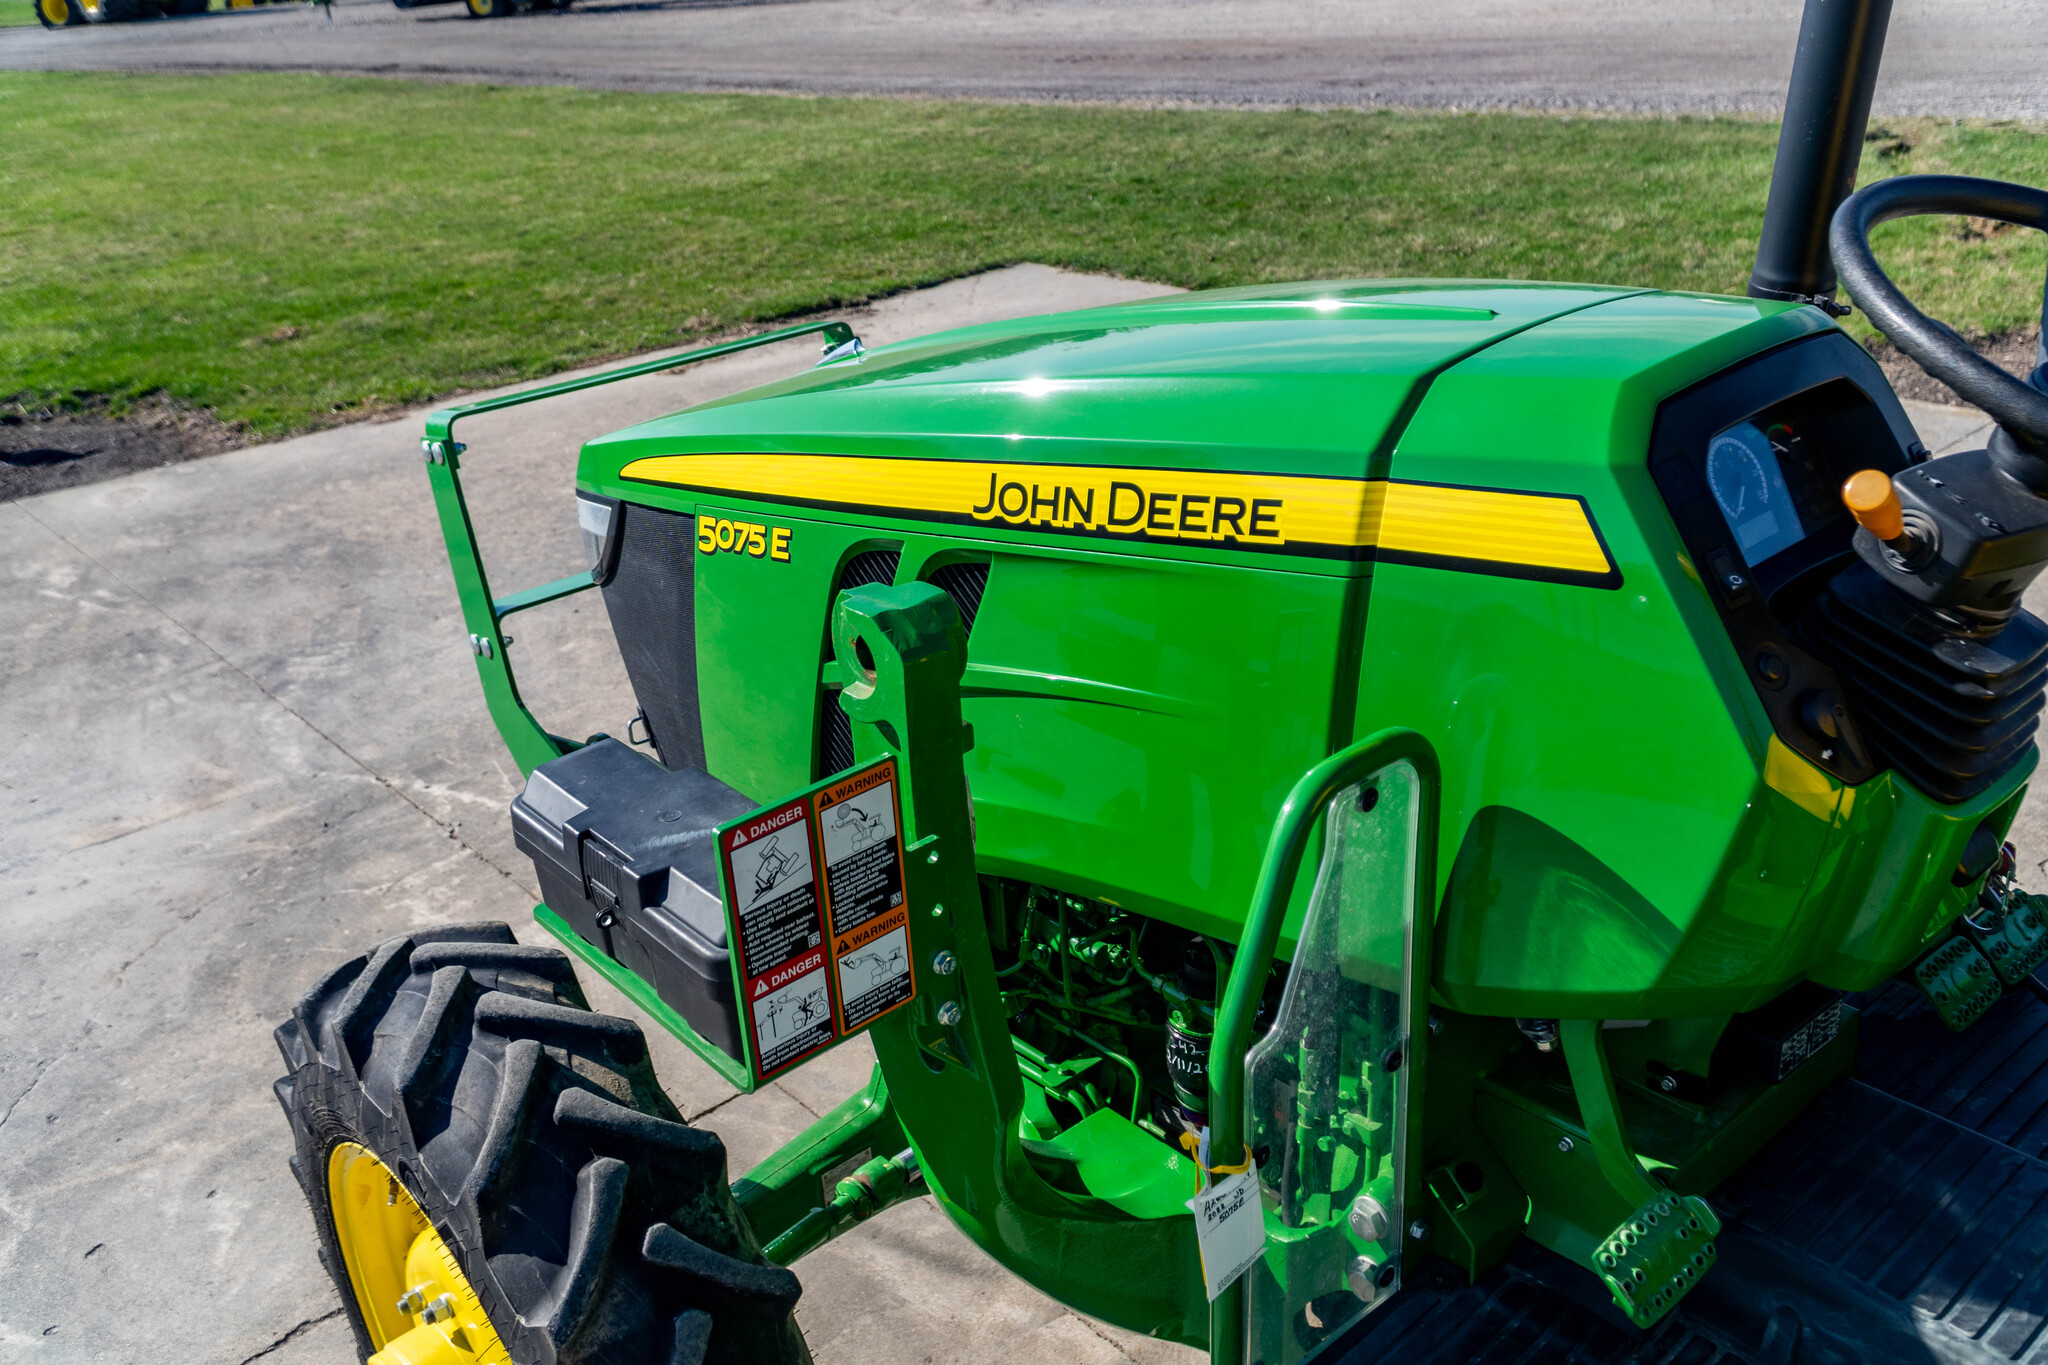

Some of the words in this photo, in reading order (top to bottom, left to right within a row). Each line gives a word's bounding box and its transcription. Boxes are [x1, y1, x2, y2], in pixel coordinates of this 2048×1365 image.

[973, 472, 1095, 527] JOHN
[1107, 481, 1284, 541] DEERE
[835, 767, 891, 799] WARNING
[750, 806, 802, 838] DANGER
[852, 912, 905, 945] WARNING
[771, 953, 821, 987] DANGER
[1219, 1196, 1245, 1224] 5075E
